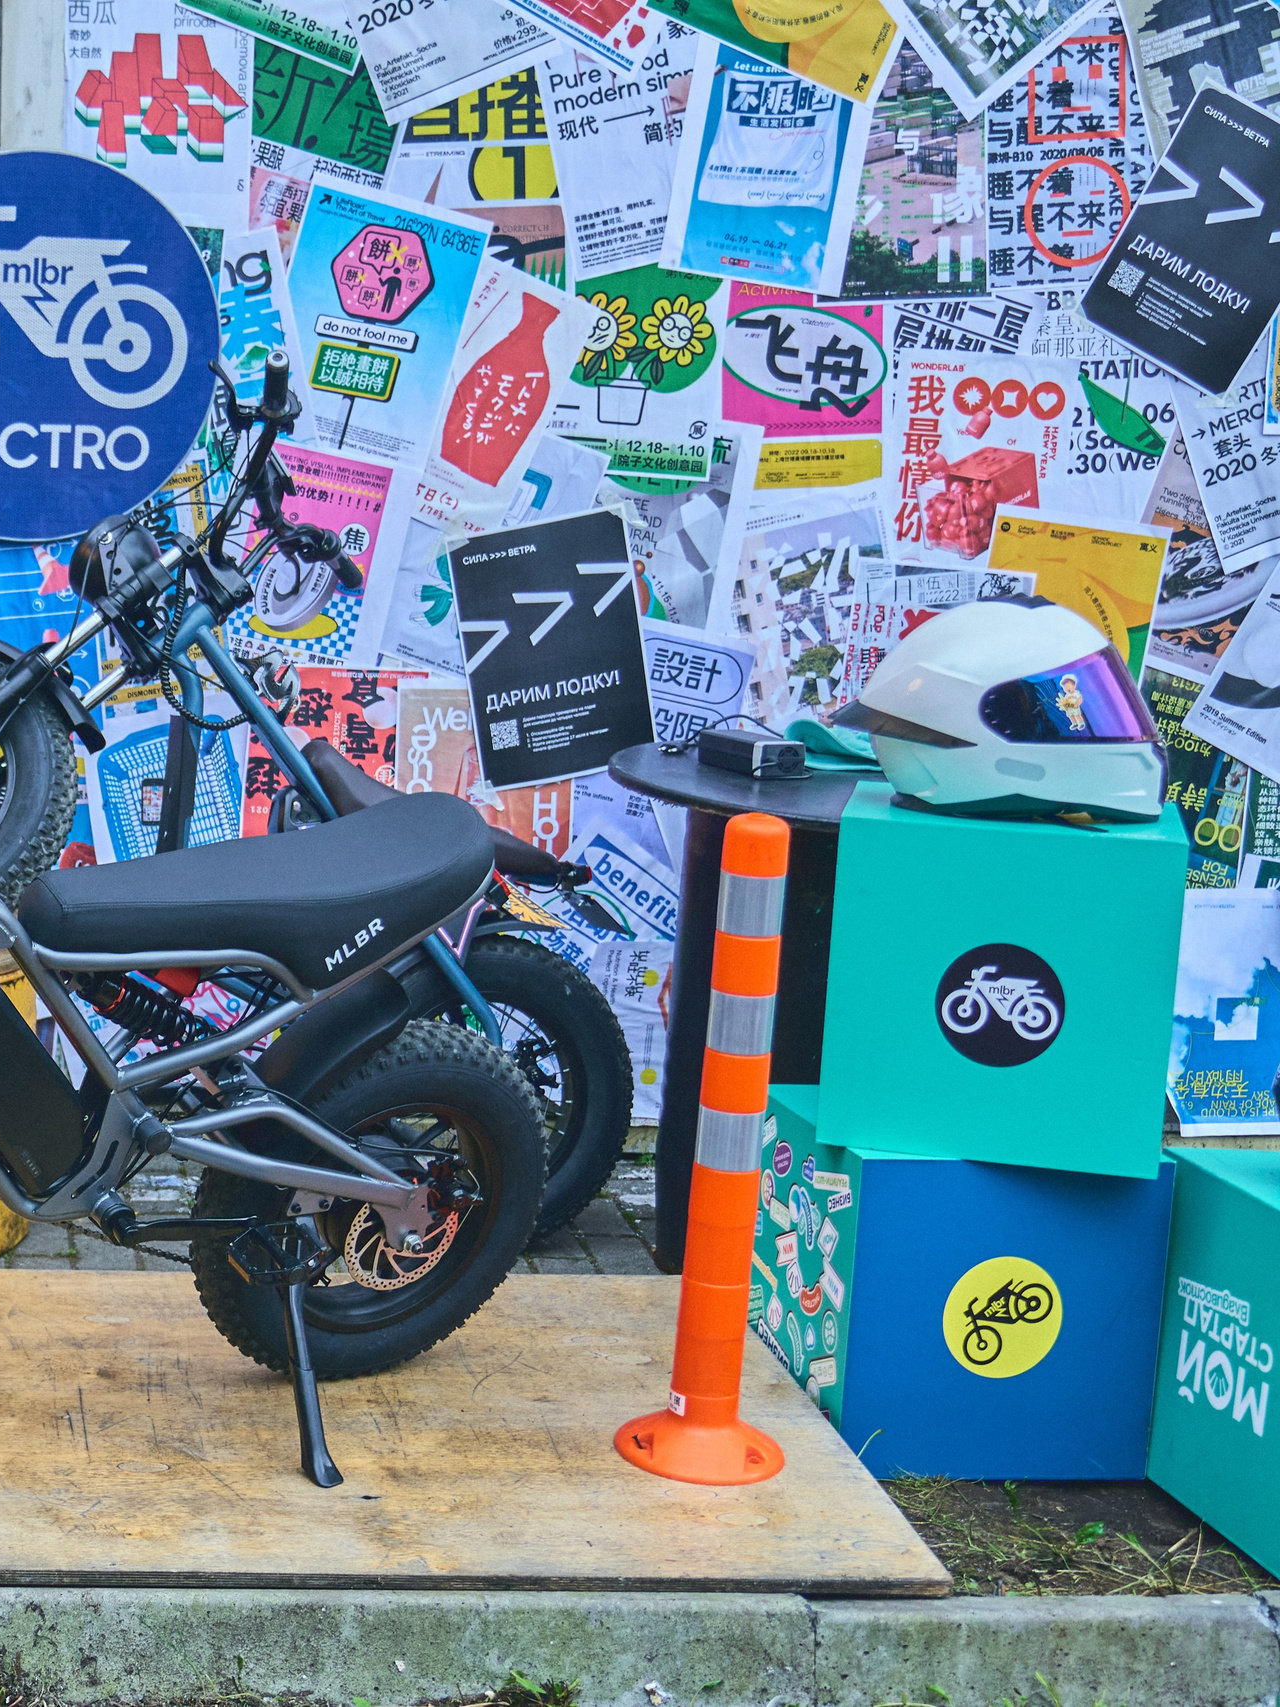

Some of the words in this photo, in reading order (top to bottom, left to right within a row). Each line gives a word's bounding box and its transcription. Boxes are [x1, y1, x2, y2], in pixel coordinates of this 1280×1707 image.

[70, 30, 91, 41] 奇妙
[70, 47, 101, 59] 大自然
[376, 65, 402, 80] Fakulta
[734, 61, 750, 71] Let
[751, 64, 765, 72] us
[549, 68, 602, 93] Pure
[392, 88, 409, 100] 2021
[554, 82, 641, 114] modern
[557, 116, 599, 141] 现代
[1204, 105, 1227, 125] СИЛА
[1243, 128, 1270, 149] ВЕТРА
[367, 212, 386, 223] Travel
[2, 257, 73, 286] mlbr
[1127, 234, 1192, 280] ДАРИМ
[1189, 269, 1252, 315] ЛОДКУ!
[323, 321, 339, 332] do
[341, 325, 362, 337] not
[363, 327, 386, 342] fool
[387, 333, 408, 345] me
[318, 366, 385, 393] 以誠相待
[1006, 438, 1018, 446] Of
[1043, 425, 1051, 449] NEW
[1051, 425, 1059, 462] HAPPY
[1212, 432, 1252, 459] 套头
[676, 442, 705, 457] 1.10
[310, 460, 334, 471] VISUAL
[336, 466, 387, 483] IMPLEMENTING
[617, 455, 703, 474] 院子文化创意园
[1039, 451, 1048, 479] YEAR
[1202, 453, 1257, 487] 2020
[351, 475, 386, 490] COMPANY
[1163, 486, 1179, 499] Two
[1216, 516, 1240, 530] Fakulta
[345, 527, 365, 553] 焦
[1139, 542, 1158, 554] 寓义
[1229, 537, 1245, 549] 2021
[462, 553, 489, 566] СИЛА
[508, 545, 537, 558] ВЕТРА
[650, 647, 722, 694] 設計
[485, 683, 550, 714] ДАРИМ
[555, 669, 621, 698] ЛОДКУ!
[1202, 703, 1220, 719] 2019
[1218, 712, 1246, 734] Summer
[1245, 725, 1267, 745] Edition
[1201, 858, 1229, 877] FOR
[324, 917, 386, 972] MLBR
[988, 984, 1016, 998] mlbr
[1211, 1100, 1236, 1109] RAIN
[1240, 1100, 1253, 1108] OF
[1251, 1089, 1270, 1100] SKY
[1200, 1107, 1238, 1117] CLOUD
[1250, 1107, 1259, 1117] IS
[828, 1192, 851, 1211] БИЗНЕС
[1179, 1280, 1249, 1325] Владивосток
[1183, 1299, 1275, 1373] СТАРТАП
[1174, 1328, 1270, 1437] МОЙ
